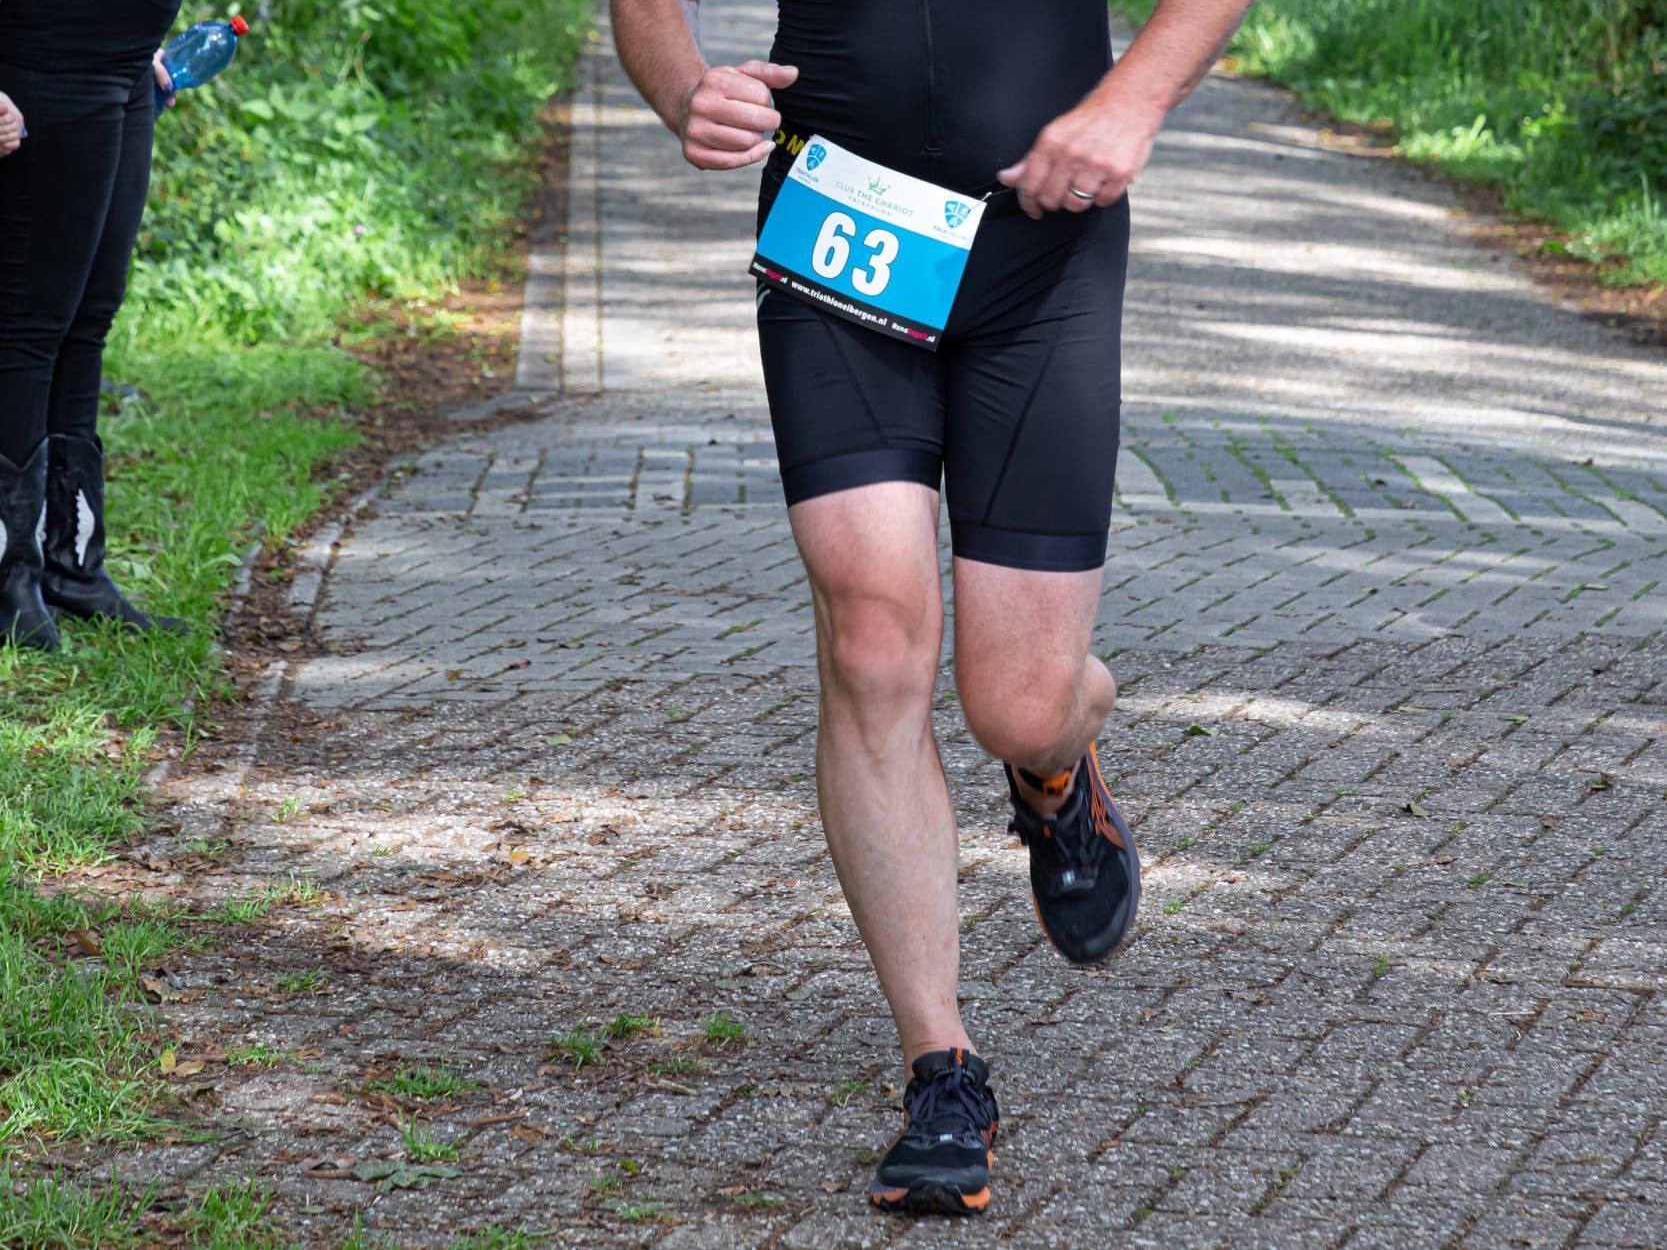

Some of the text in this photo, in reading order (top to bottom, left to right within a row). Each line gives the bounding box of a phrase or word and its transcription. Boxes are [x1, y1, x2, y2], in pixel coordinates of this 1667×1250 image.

[835, 180, 915, 216] CLUB THE CHARIOT
[848, 196, 892, 216] TRIATHLON
[811, 211, 900, 296] 63
[791, 281, 887, 326] www.triathloneibergen.nl
